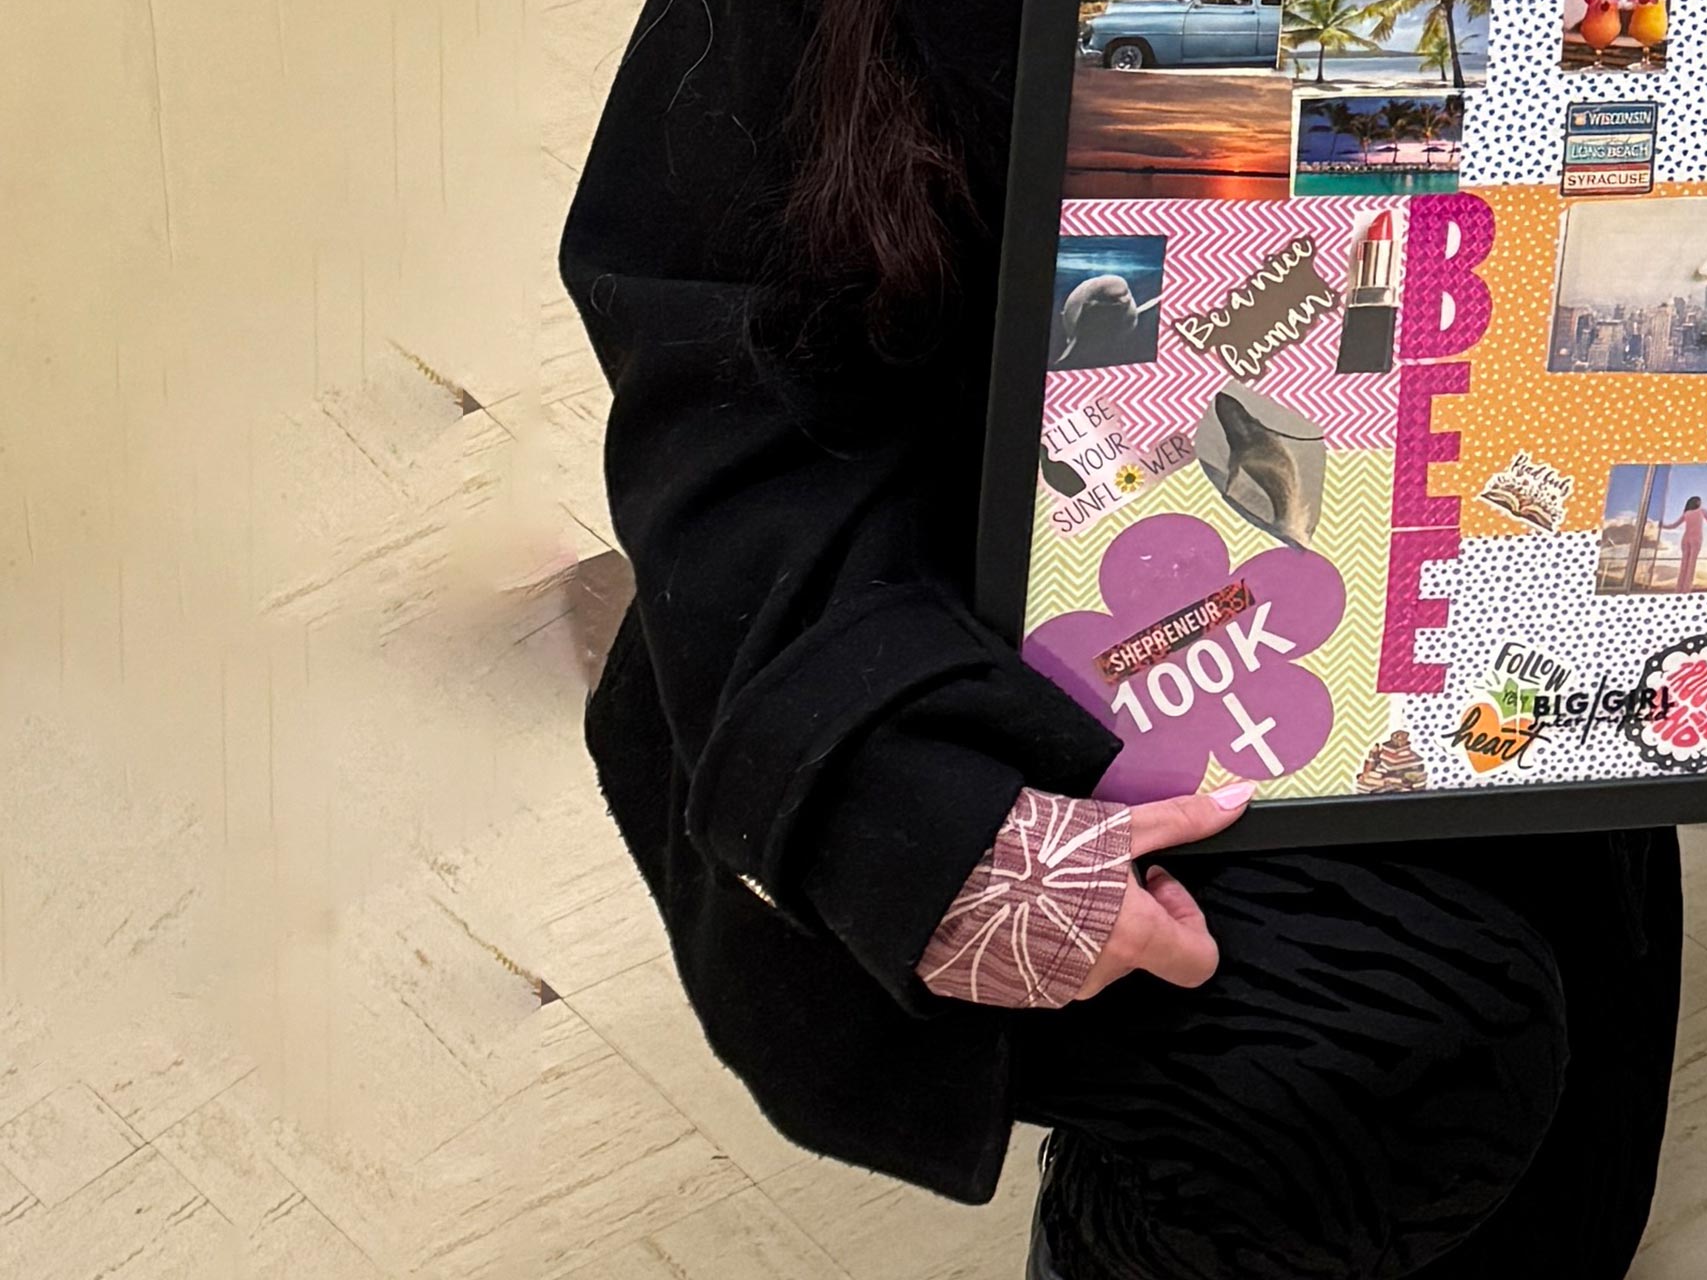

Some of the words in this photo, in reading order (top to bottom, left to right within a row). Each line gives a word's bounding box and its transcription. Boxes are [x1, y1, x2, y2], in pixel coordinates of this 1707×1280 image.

[1589, 111, 1651, 126] WISCONSIN
[1571, 144, 1606, 158] LONG
[1607, 143, 1649, 158] BEACH
[1567, 173, 1649, 186] SYRACUSE
[1175, 310, 1230, 349] Be
[1231, 290, 1255, 310] a
[1252, 240, 1312, 290] nice
[1221, 291, 1335, 376] human.
[1043, 419, 1088, 454] I'LL
[1083, 397, 1115, 428] BE
[1073, 433, 1131, 475] YOUR
[1110, 601, 1222, 672] SHEPRENEUR
[1111, 601, 1296, 733] 100K
[1495, 642, 1571, 690] FOLLOW
[1441, 707, 1552, 769] heart
